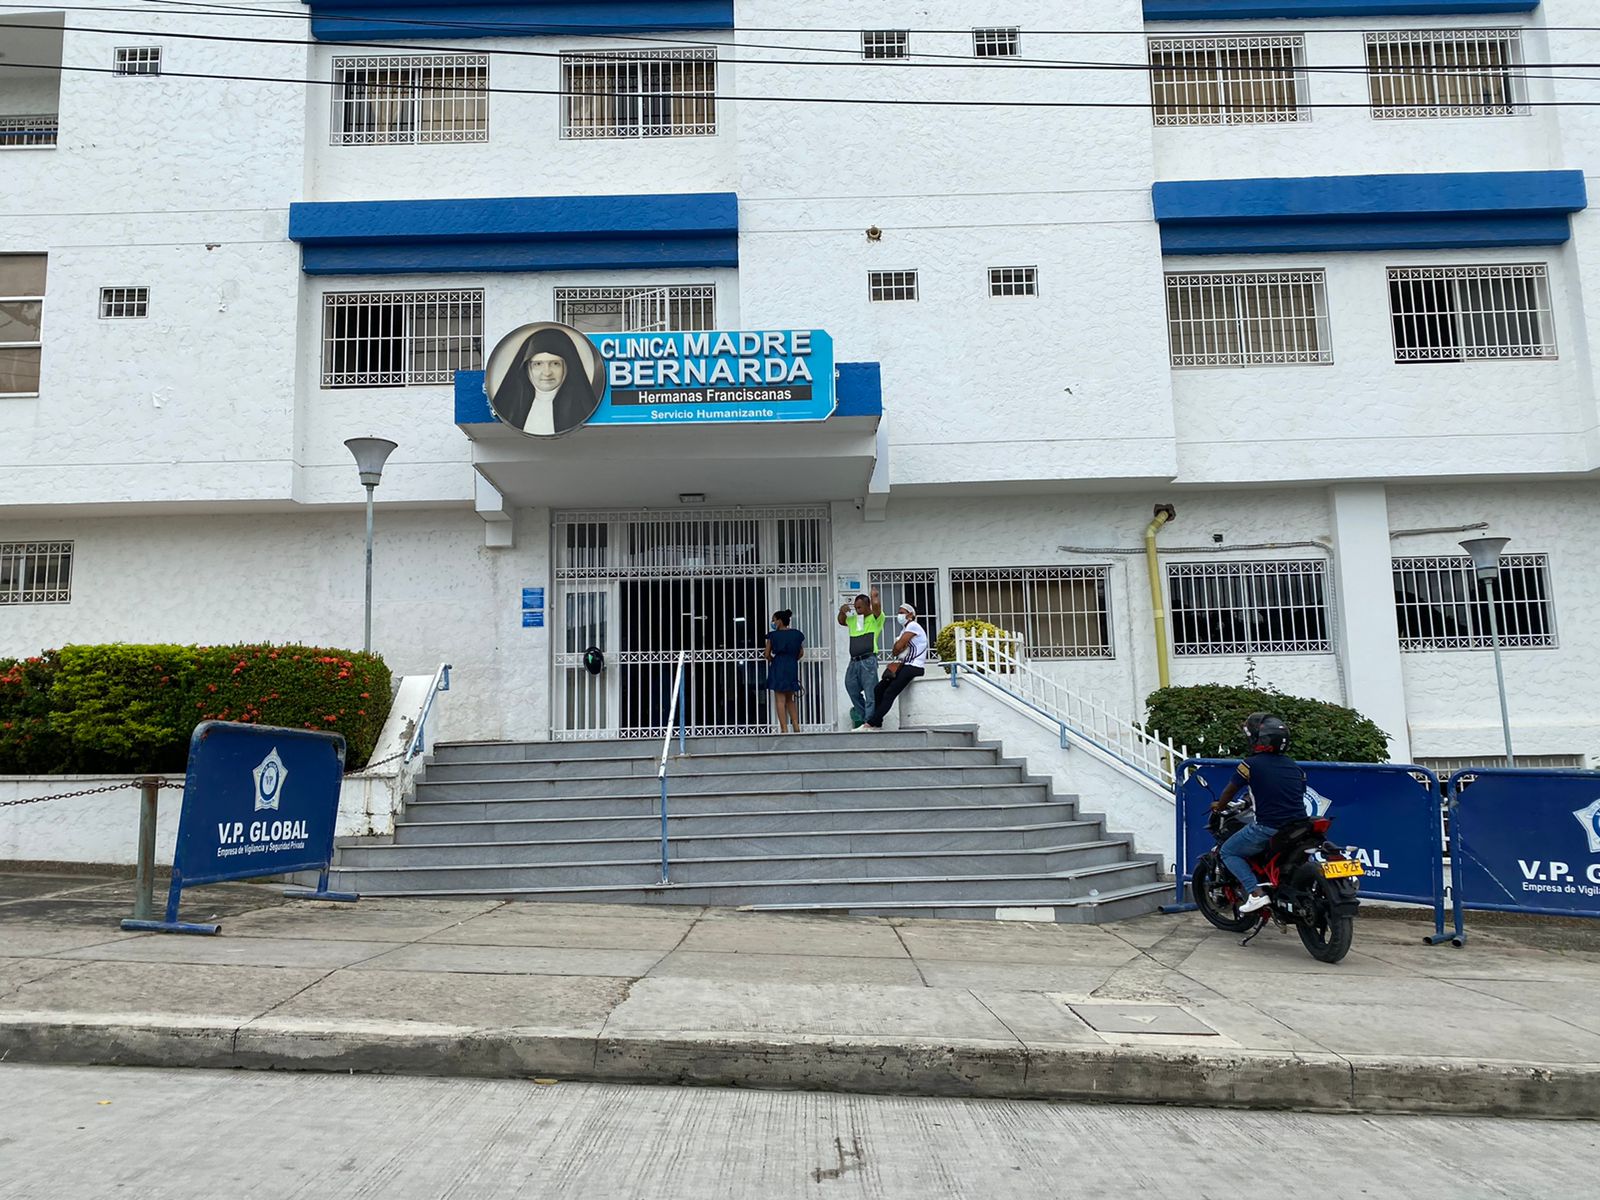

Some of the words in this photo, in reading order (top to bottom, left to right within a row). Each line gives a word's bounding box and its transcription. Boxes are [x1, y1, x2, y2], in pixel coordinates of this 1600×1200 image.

[600, 338, 679, 359] CLINICA
[683, 331, 812, 356] MADRE
[609, 357, 813, 386] BERNARDA
[638, 391, 703, 403] Hermanas
[706, 388, 792, 402] Franciscanas
[651, 410, 694, 419] Servicio
[697, 408, 774, 419] Humanizante
[218, 822, 245, 844] V.P.
[249, 820, 309, 842] GLOBAL
[217, 846, 238, 858] Empresa
[238, 845, 244, 854] de
[244, 843, 265, 855] Vigilancia
[269, 841, 290, 853] Seguridad
[290, 840, 305, 849] Privada
[1517, 859, 1574, 882] V.P.
[1522, 882, 1562, 893] Empresa
[1564, 884, 1576, 894] de
